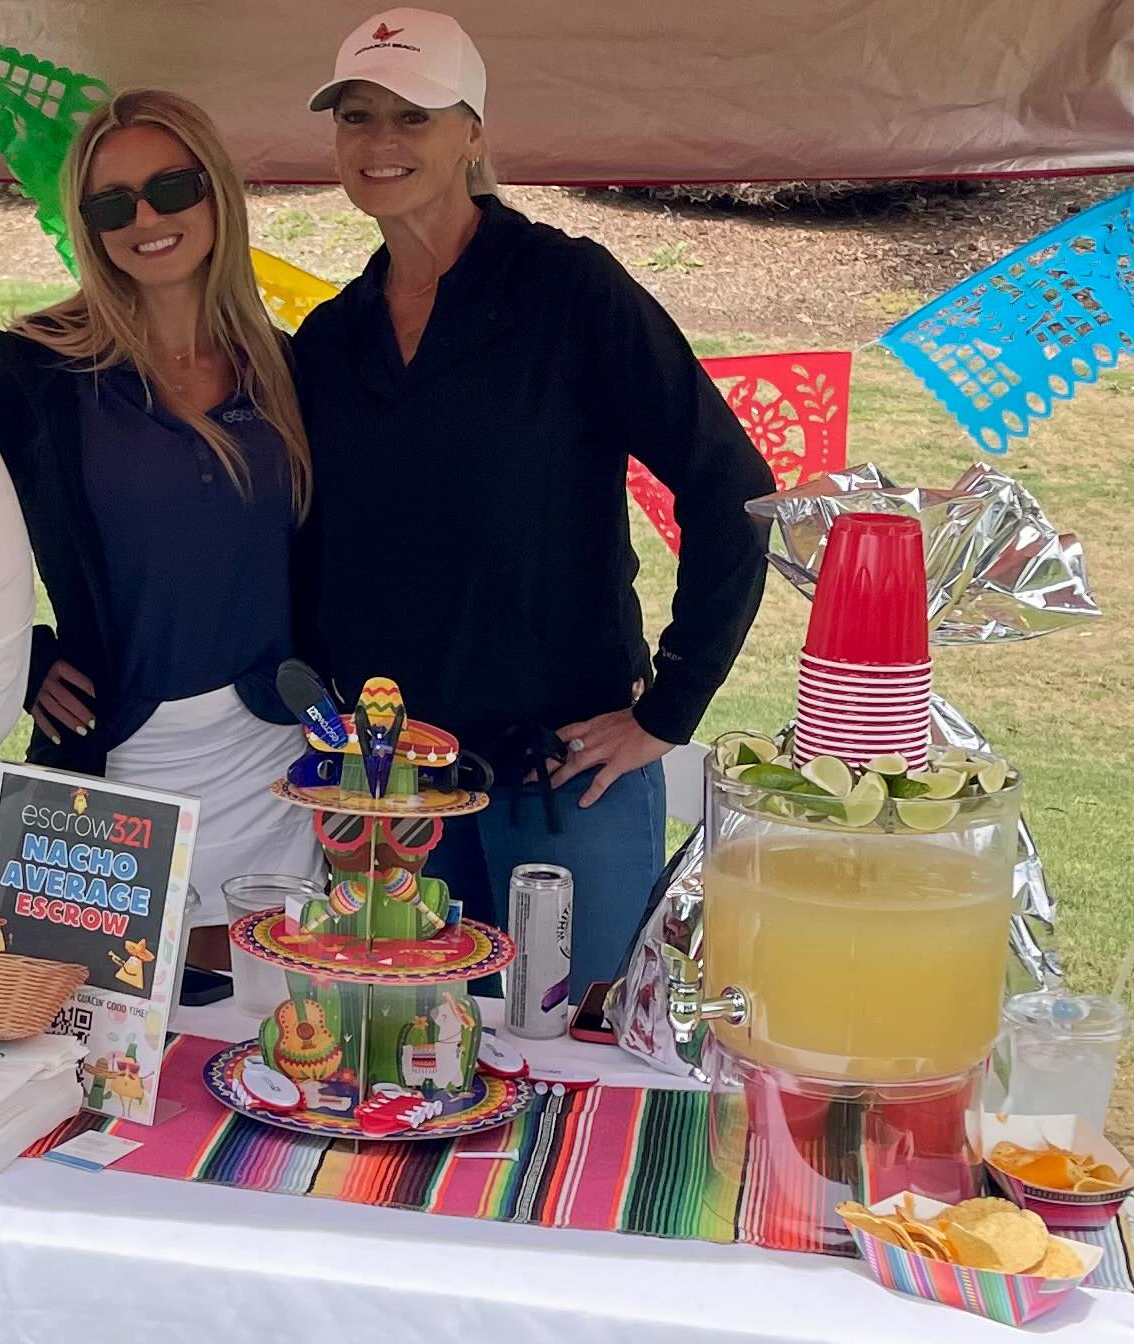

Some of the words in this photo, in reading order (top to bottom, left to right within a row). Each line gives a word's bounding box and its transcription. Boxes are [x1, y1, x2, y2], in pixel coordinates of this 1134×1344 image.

[21, 804, 153, 849] escrow321
[21, 832, 138, 880] NACHO
[0, 860, 151, 917] AVERAGE
[14, 892, 130, 938] ESCROW
[106, 1000, 127, 1013] GOOD
